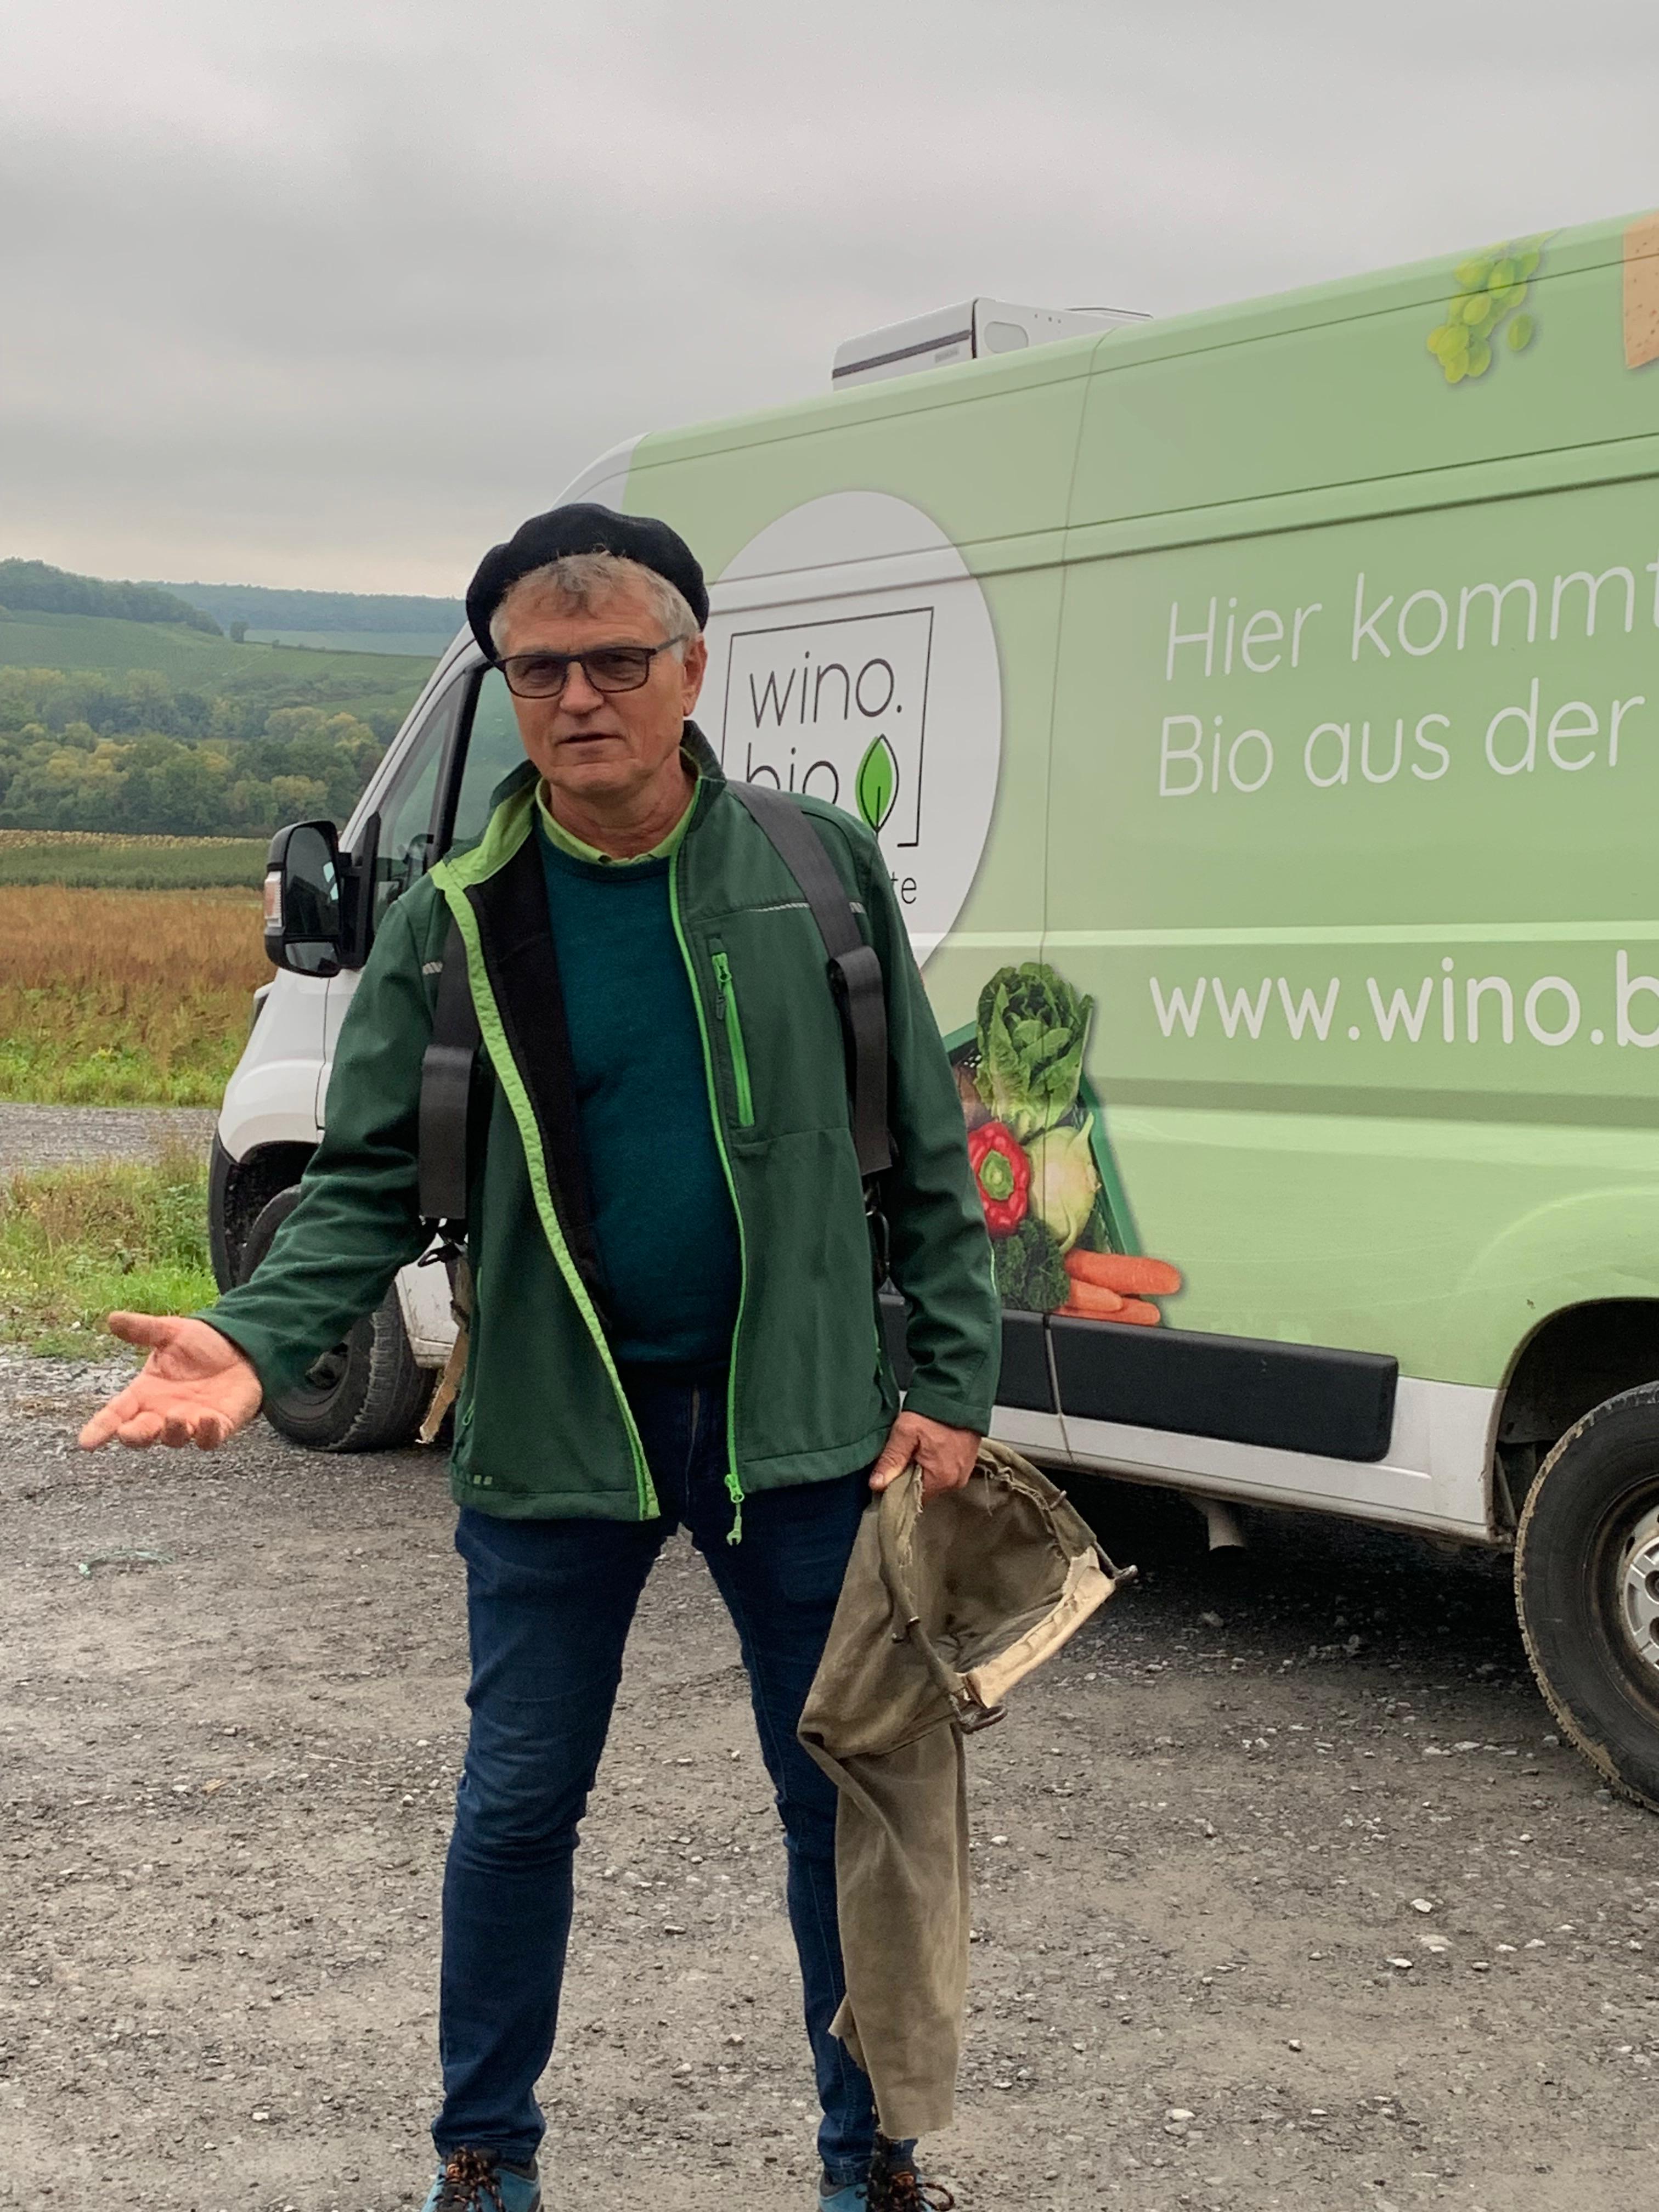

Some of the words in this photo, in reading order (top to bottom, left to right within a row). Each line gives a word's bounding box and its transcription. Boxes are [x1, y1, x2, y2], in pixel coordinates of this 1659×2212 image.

[1163, 596, 1323, 684] Hier
[749, 651, 902, 728] wino.
[1158, 713, 1274, 798] Bio
[1304, 713, 1451, 788] aus
[1485, 678, 1646, 775] der
[1149, 950, 1659, 1048] www.wino.b
